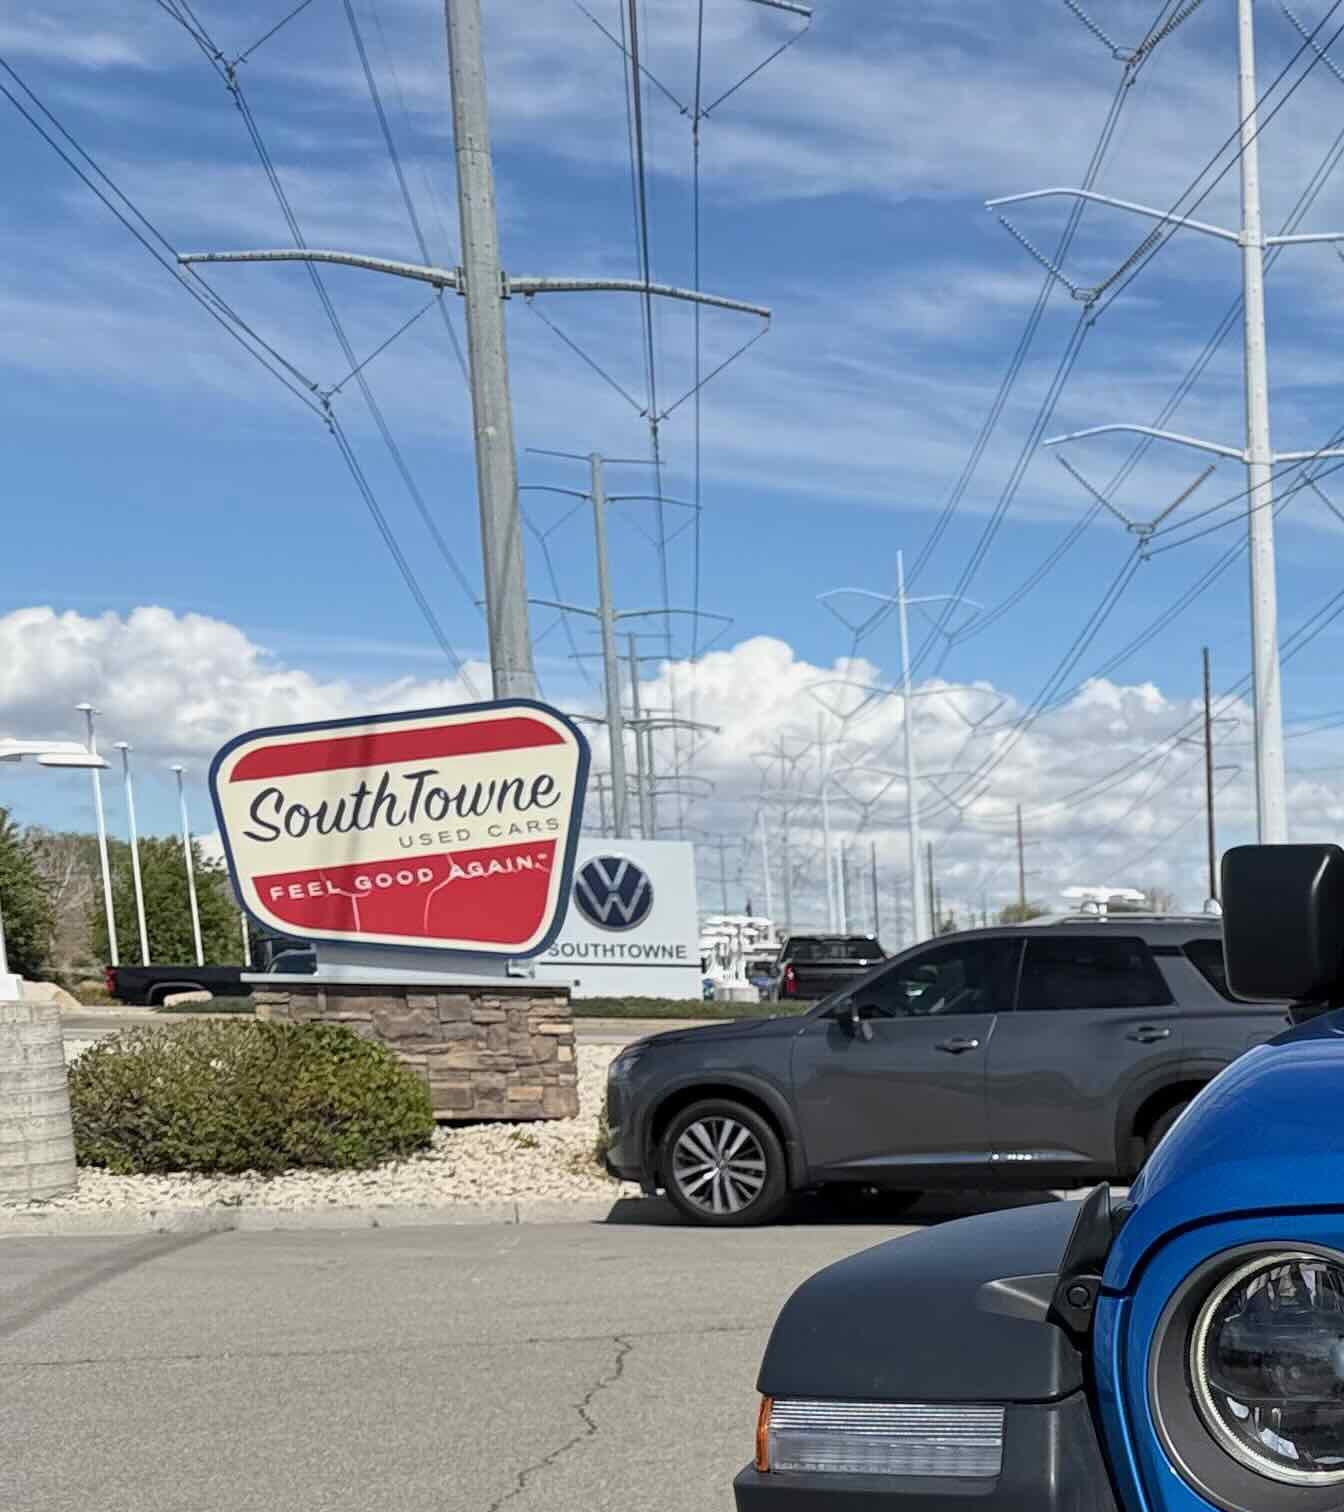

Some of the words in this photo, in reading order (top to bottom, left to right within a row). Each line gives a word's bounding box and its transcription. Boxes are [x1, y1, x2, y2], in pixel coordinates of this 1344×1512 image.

[399, 827, 471, 849] USED
[487, 817, 561, 838] CARS
[270, 878, 341, 901] FEEL
[354, 867, 433, 891] GOOD
[548, 942, 687, 959] SOUTHTOWNE
